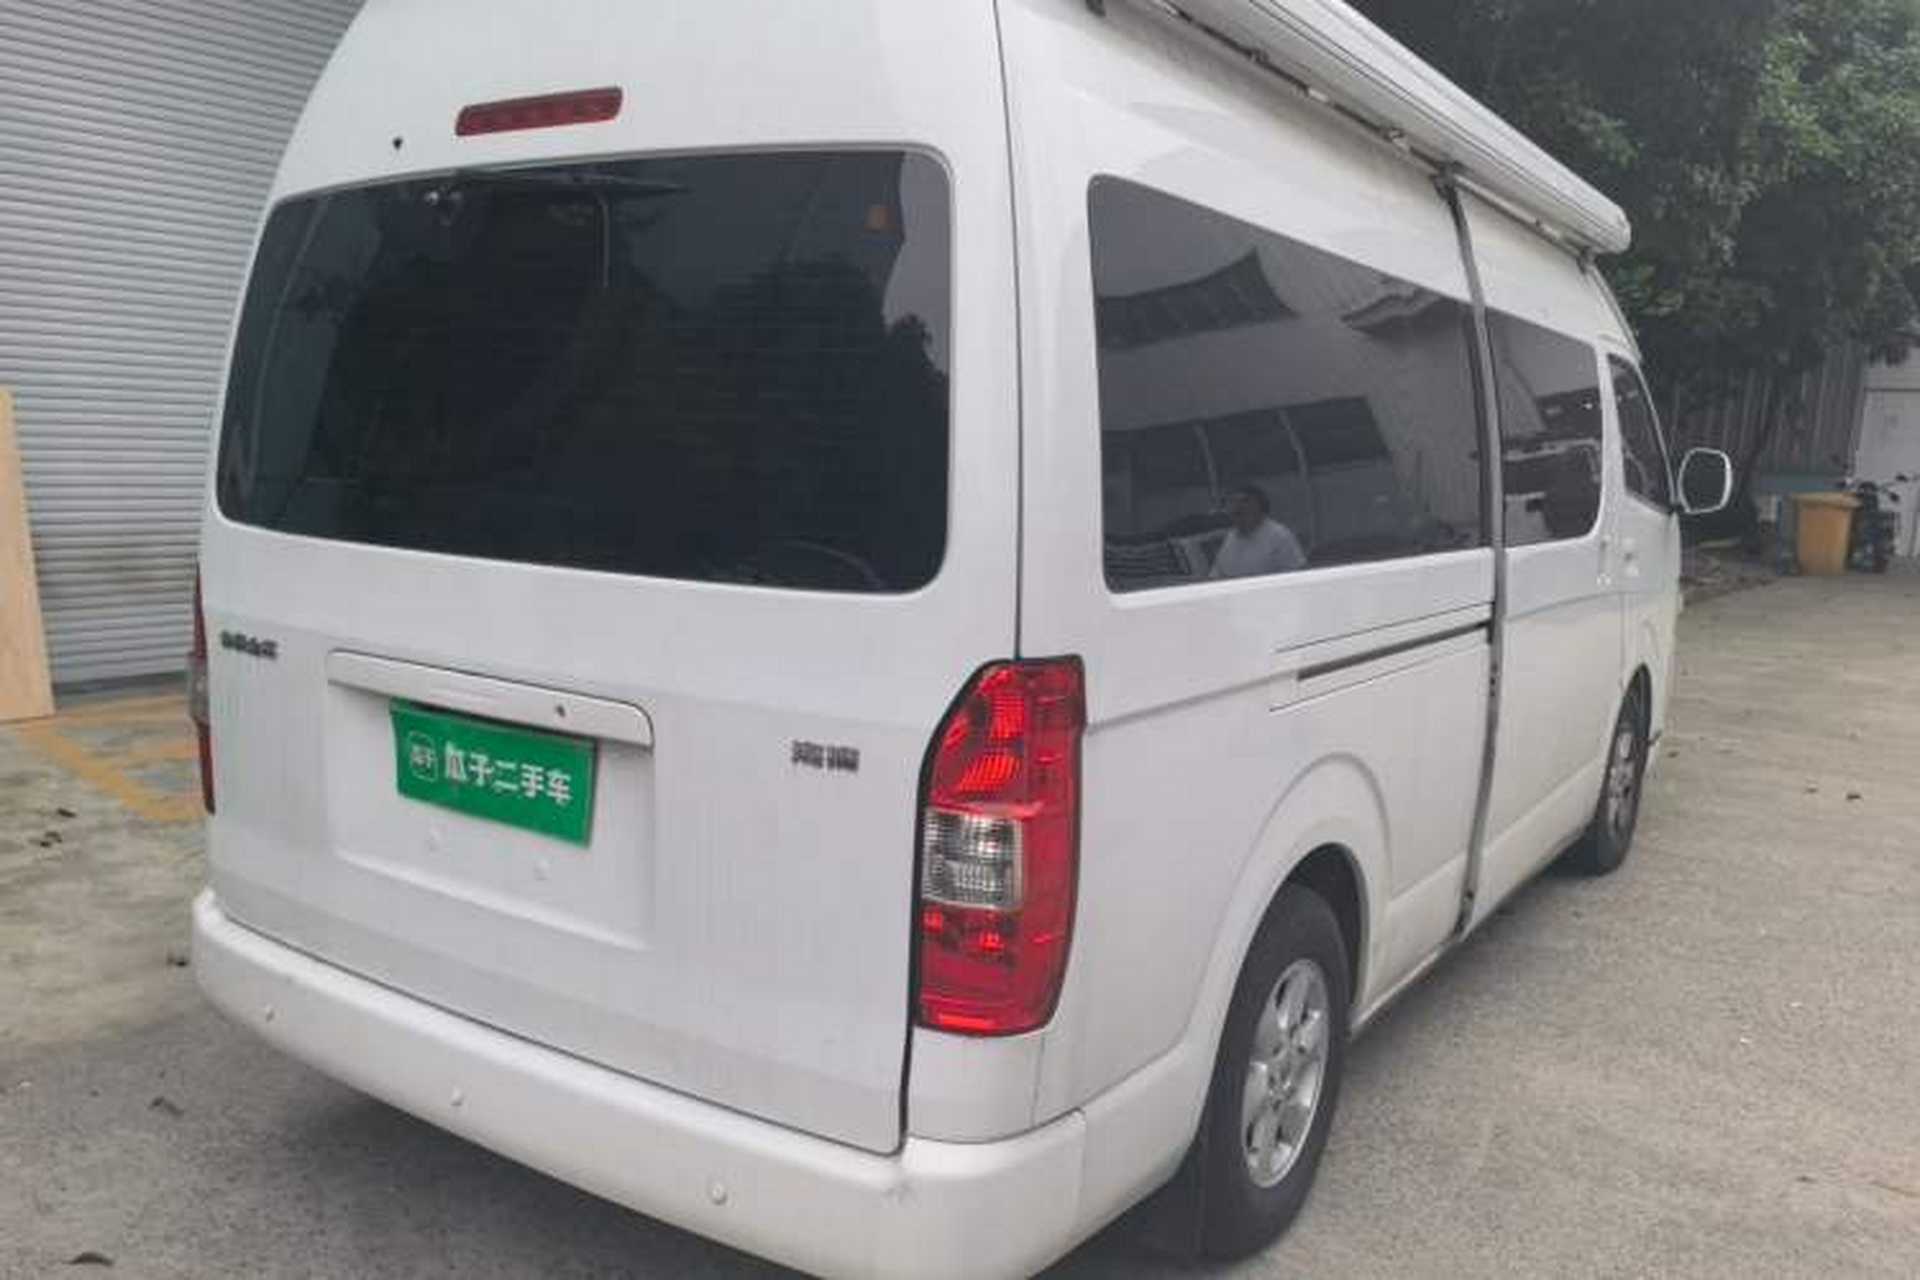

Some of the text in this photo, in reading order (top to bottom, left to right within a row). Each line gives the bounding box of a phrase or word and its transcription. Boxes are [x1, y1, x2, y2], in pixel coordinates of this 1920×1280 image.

[445, 740, 572, 806] 瓜子二手车
